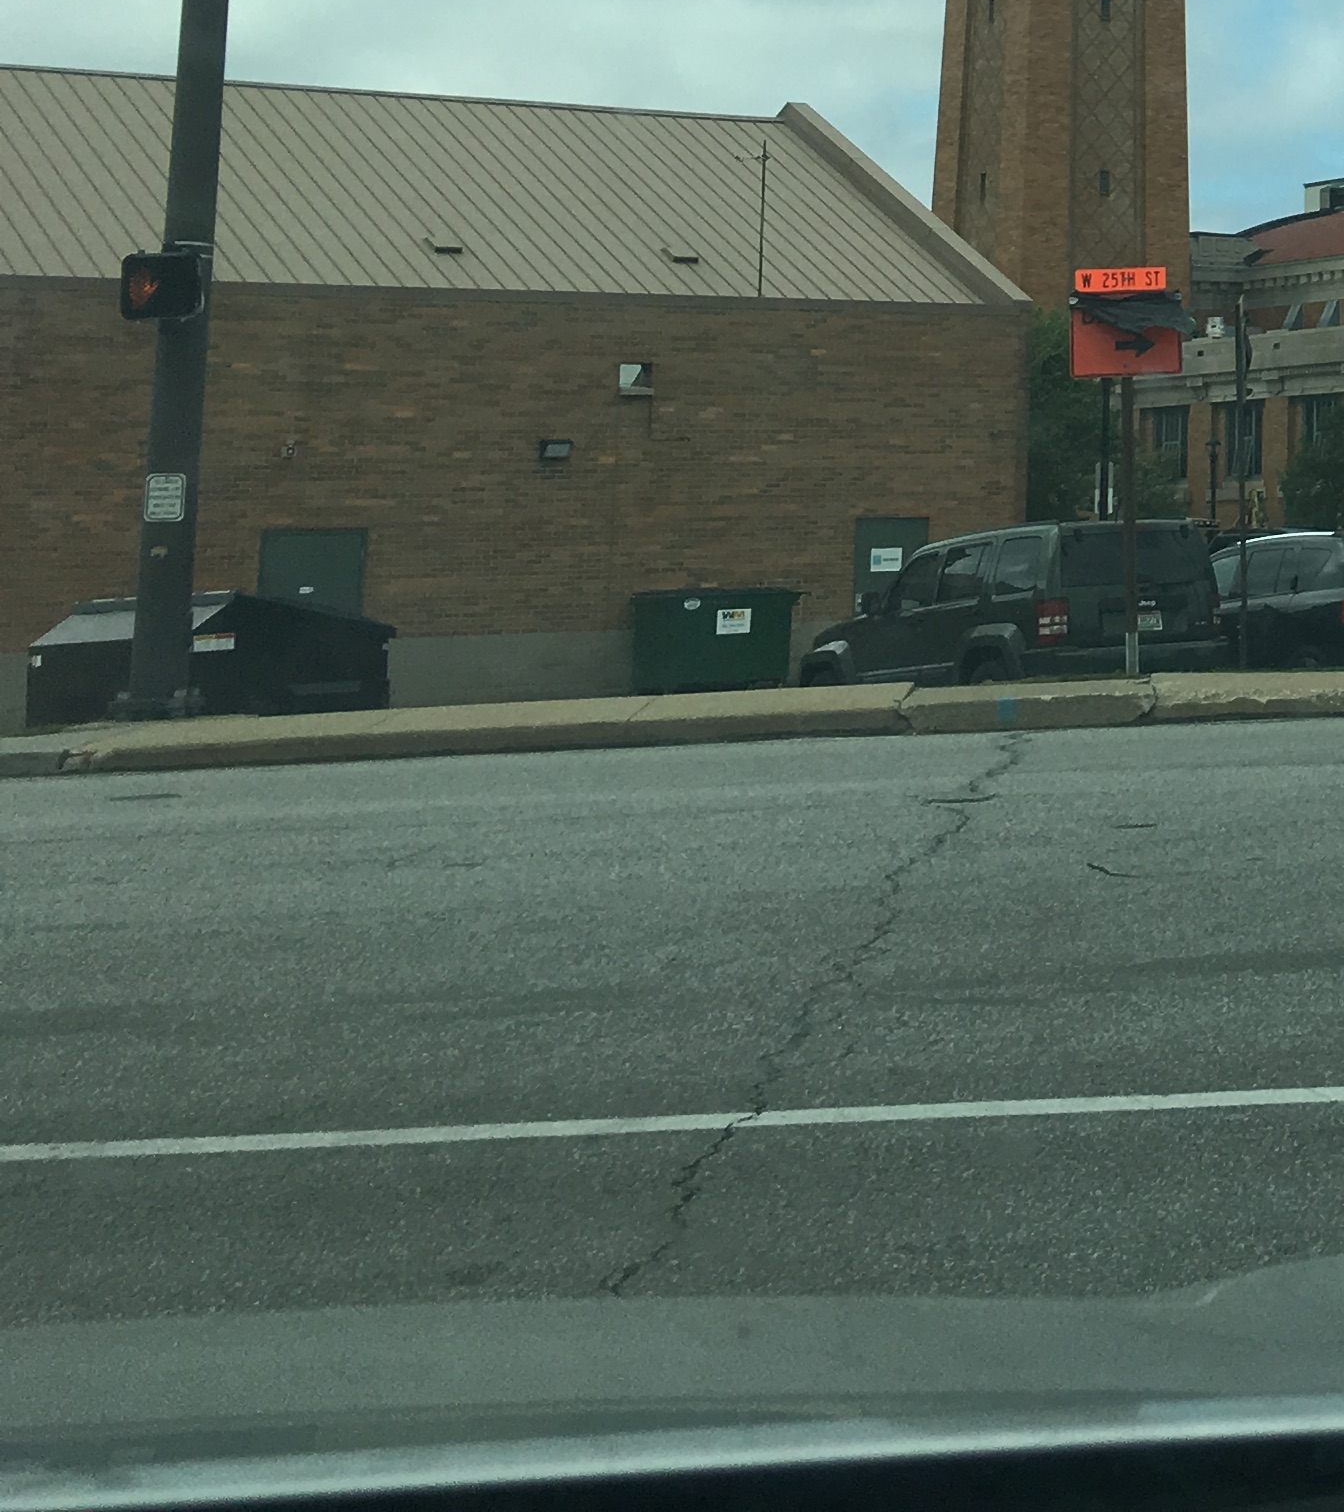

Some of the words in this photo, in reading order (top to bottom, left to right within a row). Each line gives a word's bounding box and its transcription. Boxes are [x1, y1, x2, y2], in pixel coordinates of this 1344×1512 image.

[1081, 273, 1092, 288] W
[1102, 271, 1136, 288] 25TH
[1145, 271, 1160, 286] ST
